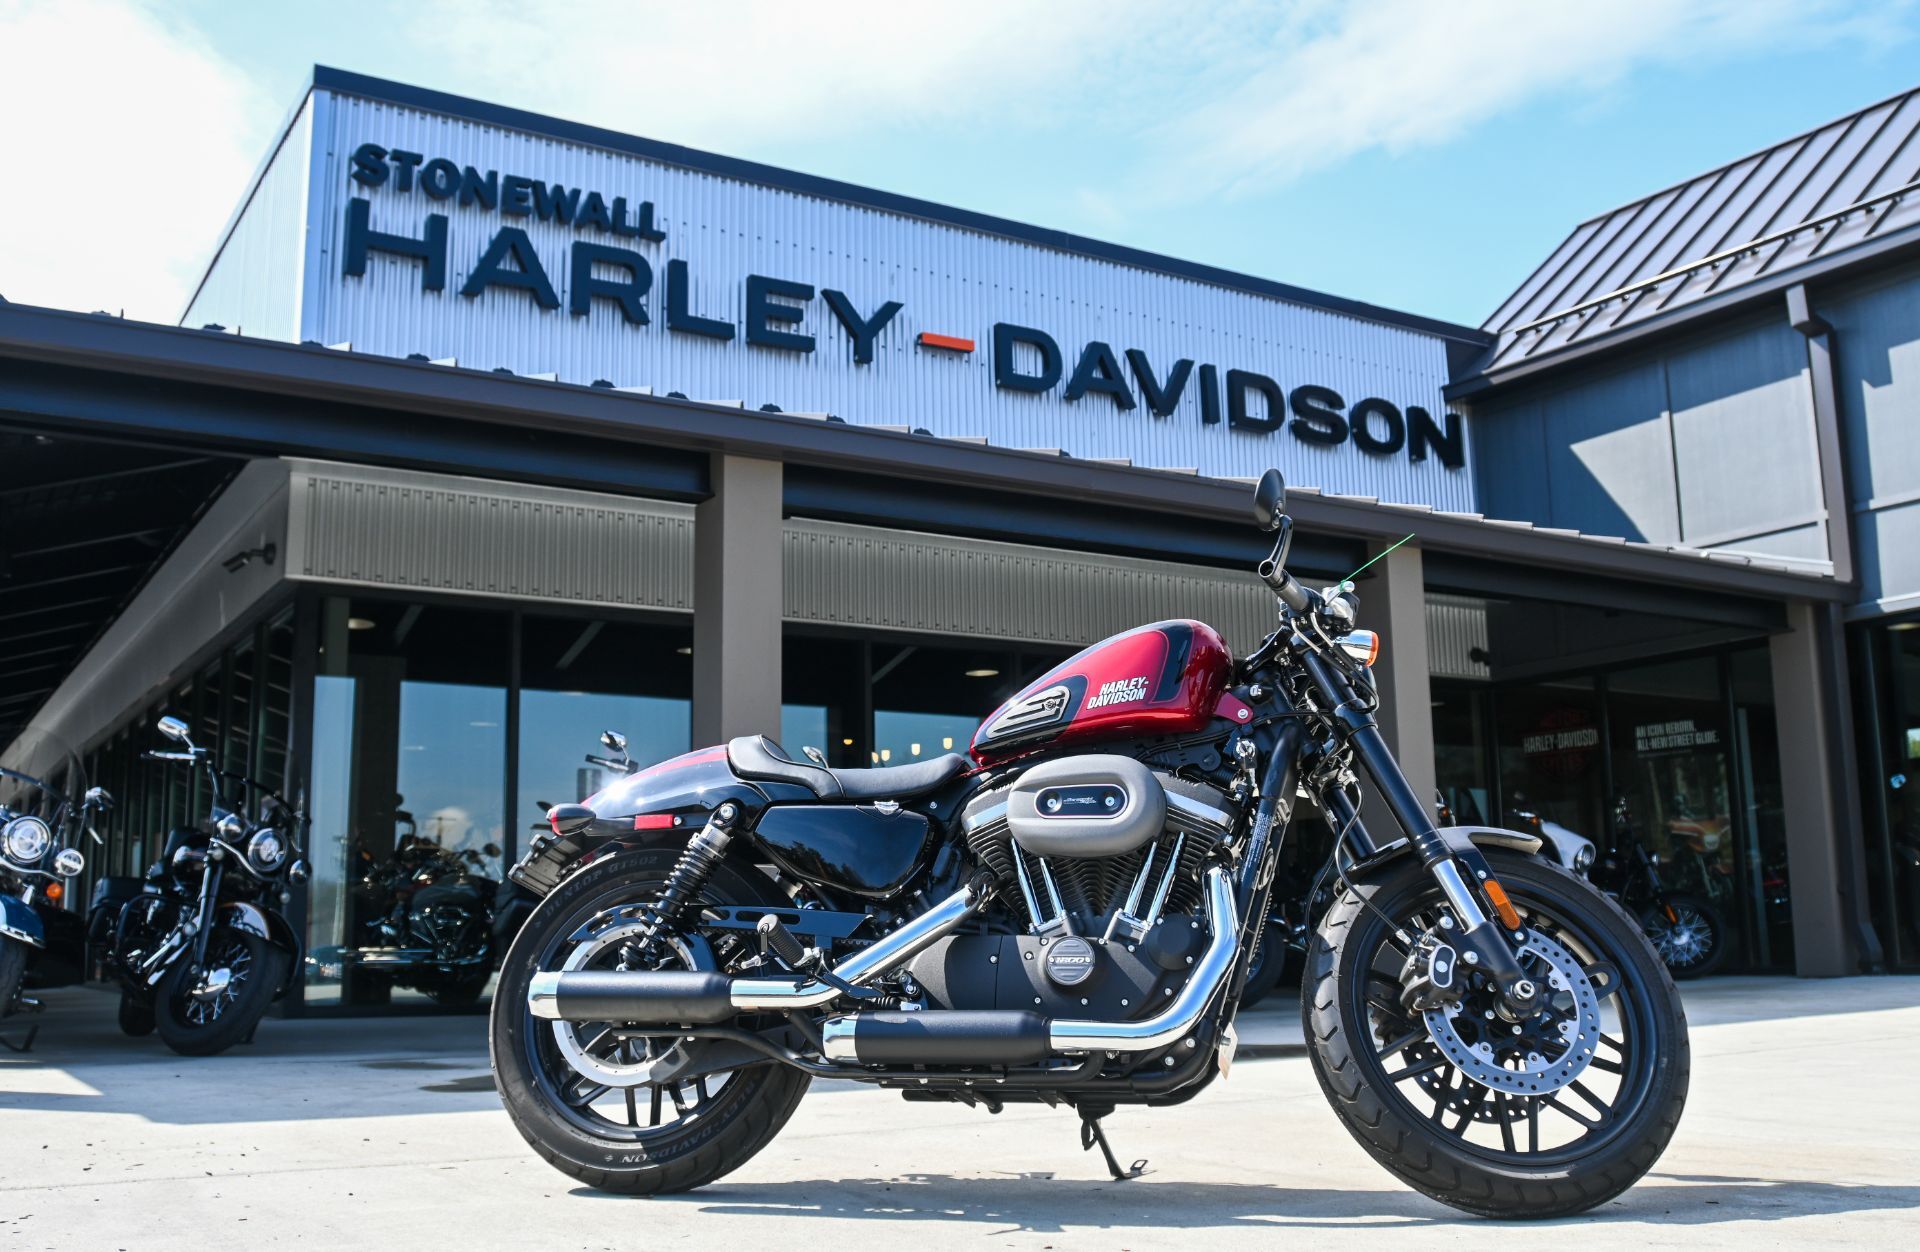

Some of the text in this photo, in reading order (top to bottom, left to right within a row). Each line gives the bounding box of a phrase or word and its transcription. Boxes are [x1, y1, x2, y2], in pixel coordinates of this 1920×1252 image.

[351, 143, 667, 243] STONEWALL
[1098, 676, 1149, 696] HARLEY-
[1087, 688, 1147, 710] DAVIDSON
[1668, 733, 1694, 748] STREET
